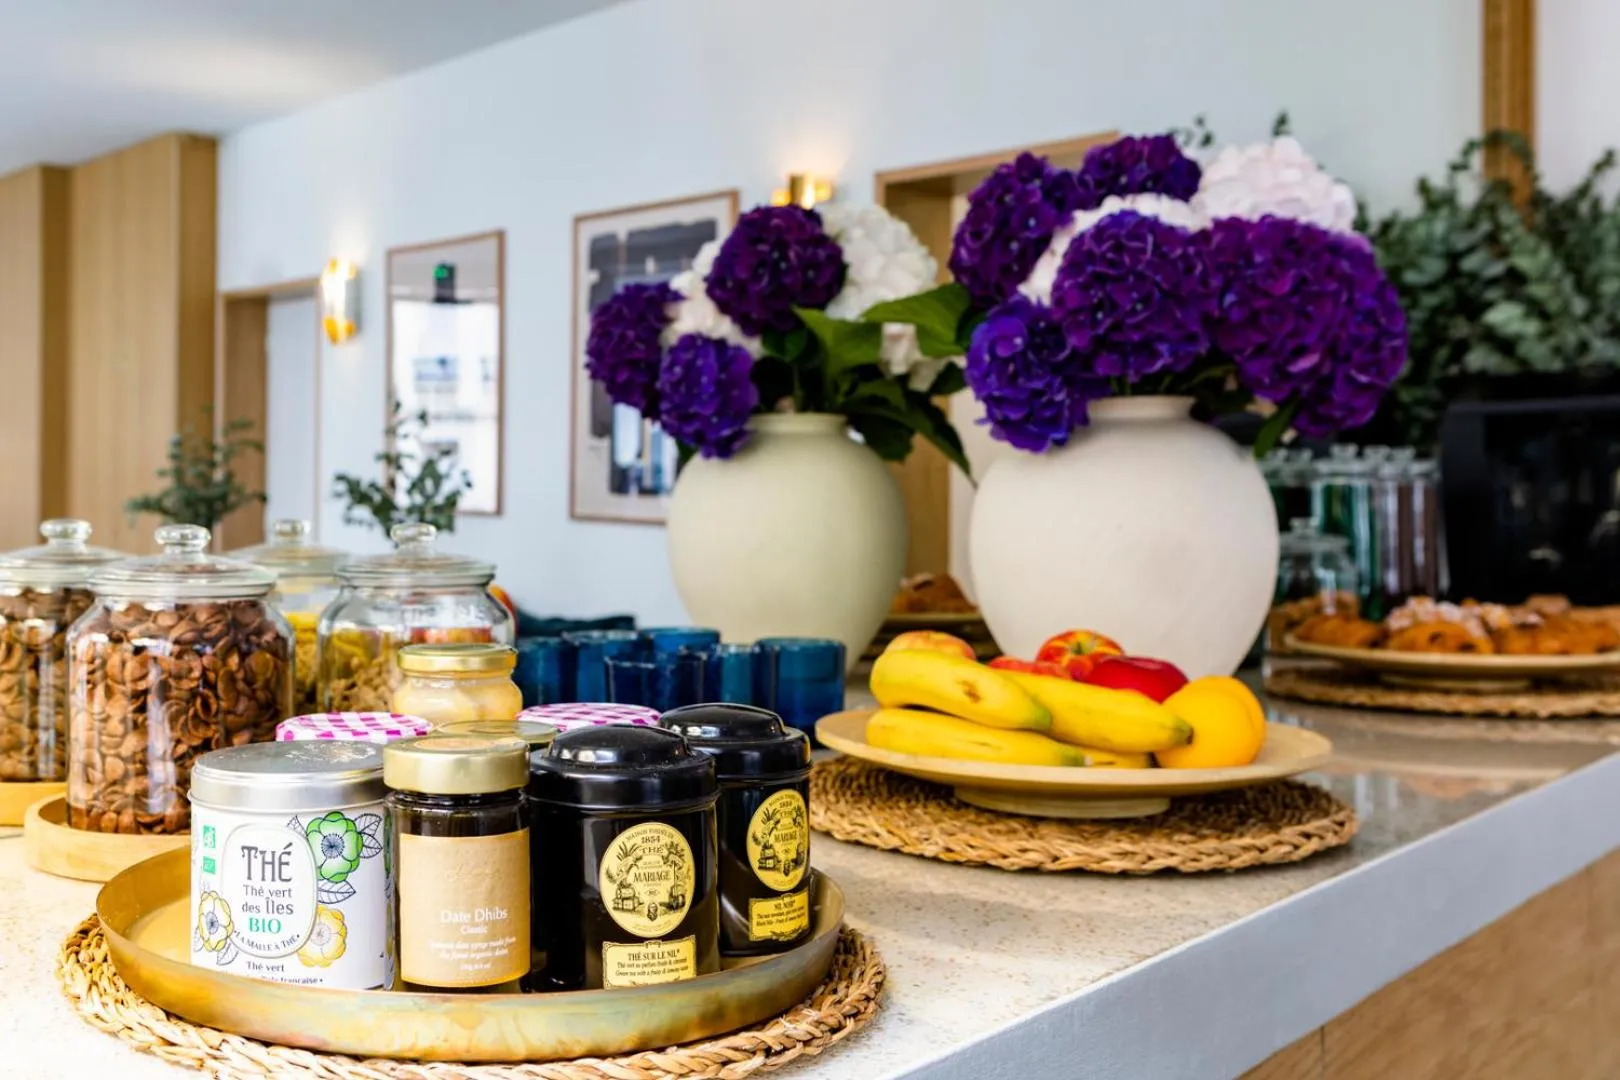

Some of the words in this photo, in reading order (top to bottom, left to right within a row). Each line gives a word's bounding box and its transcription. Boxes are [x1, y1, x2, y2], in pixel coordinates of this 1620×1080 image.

[241, 842, 293, 882] THÉ
[633, 871, 670, 882] MARIAGE
[243, 884, 264, 897] Thé
[269, 888, 292, 898] vert
[242, 902, 261, 914] des
[265, 897, 294, 915] Îles
[440, 909, 471, 923] Date
[474, 906, 508, 921] Dhibs
[249, 917, 281, 934] BIO
[628, 950, 641, 961] THÉ
[643, 951, 656, 960] SUR
[657, 951, 665, 959] LE
[247, 961, 263, 971] Thé
[266, 963, 284, 972] vert
